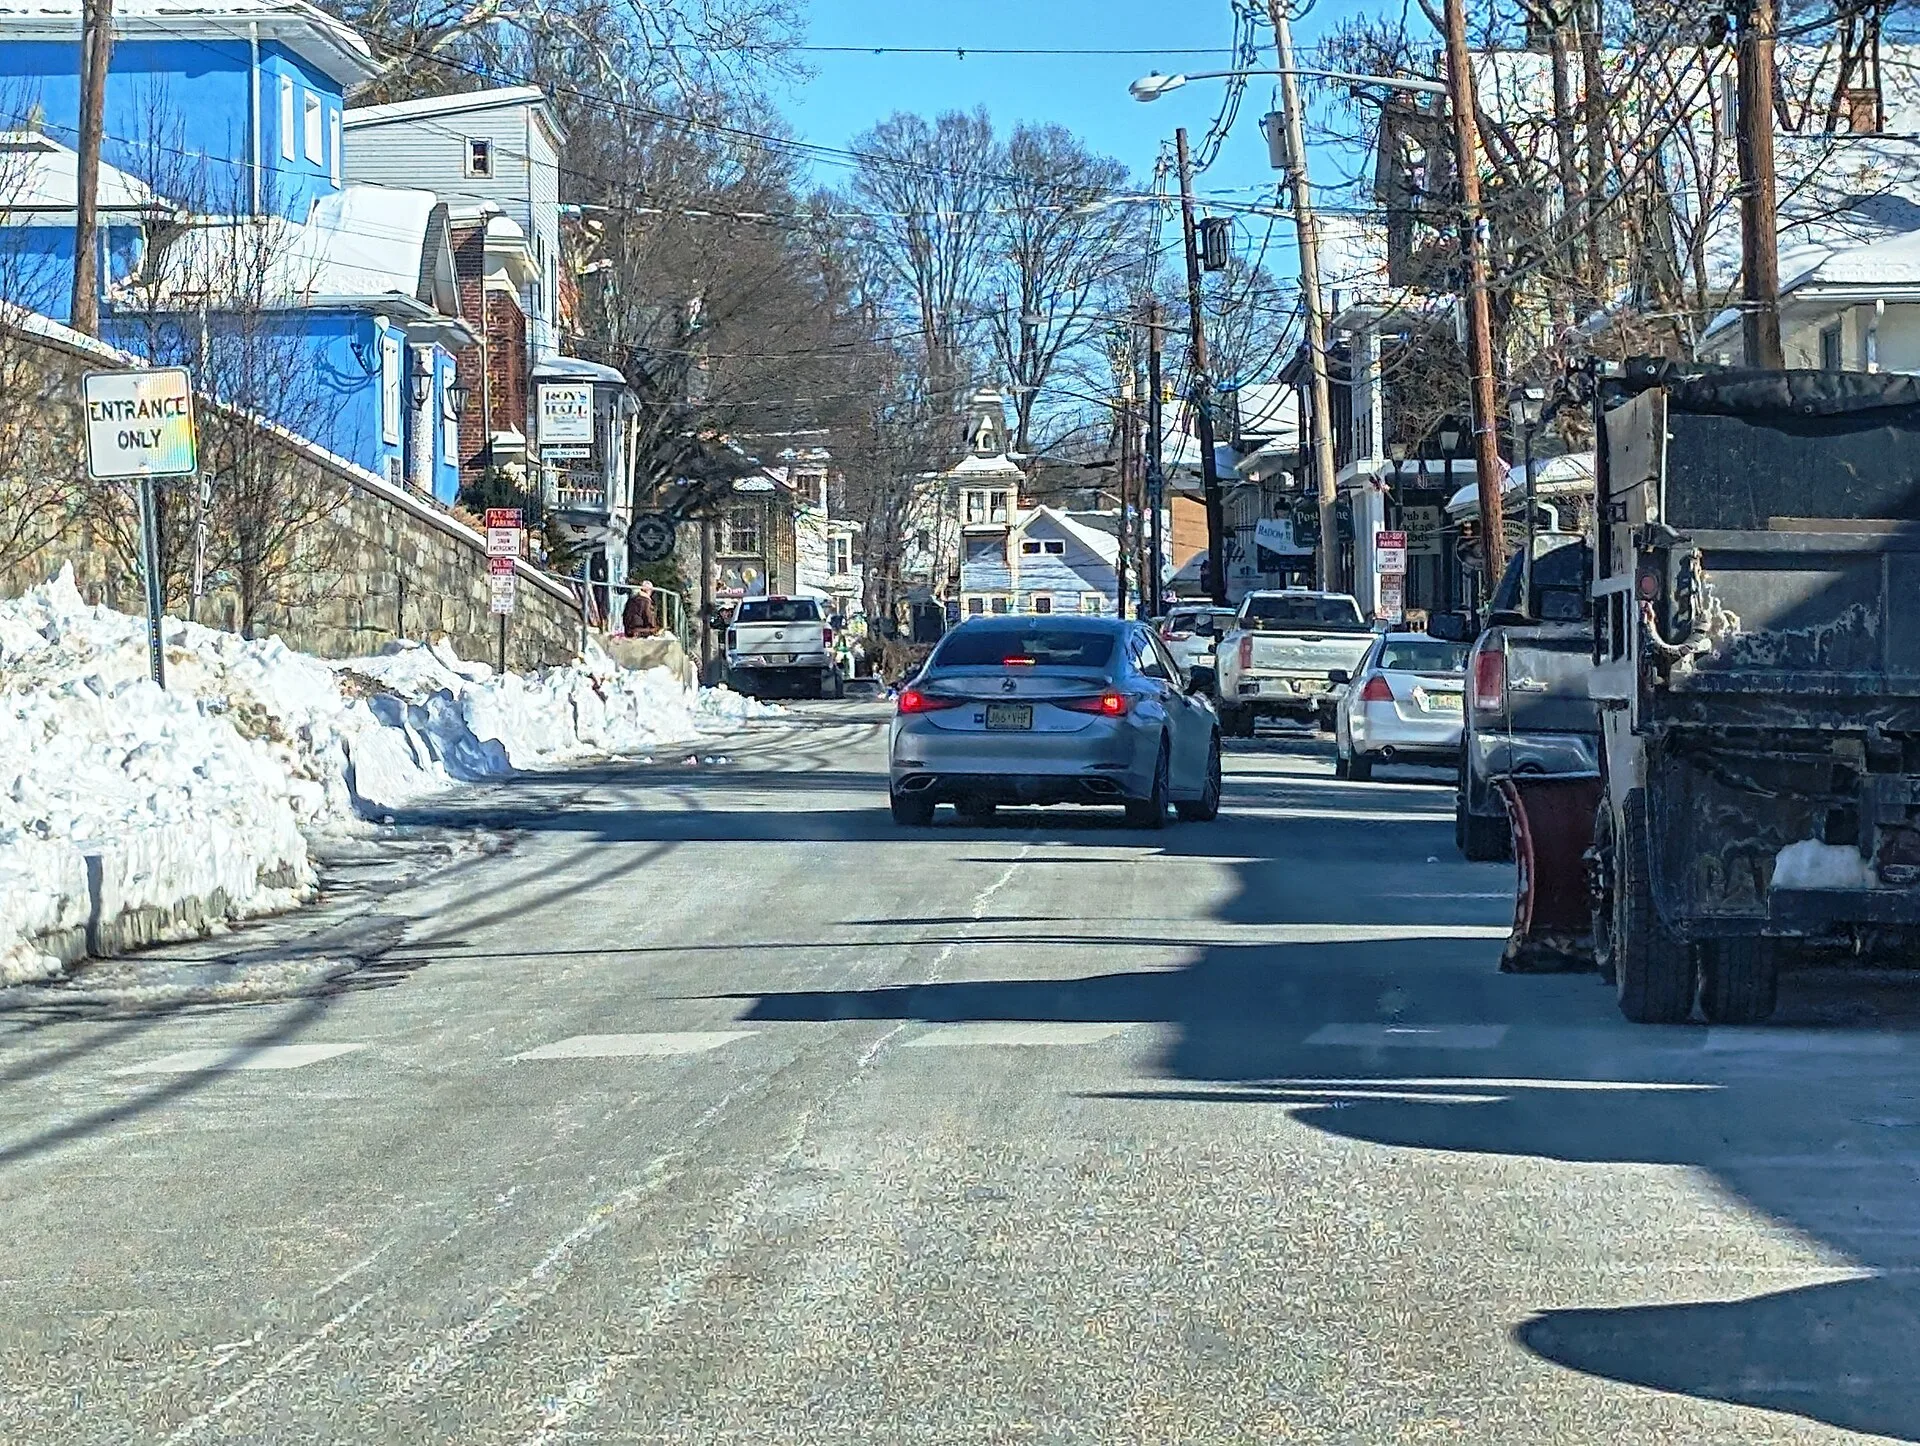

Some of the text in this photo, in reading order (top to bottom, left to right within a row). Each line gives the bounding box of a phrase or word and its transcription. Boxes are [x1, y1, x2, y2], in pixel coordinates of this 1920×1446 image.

[89, 397, 187, 421] ENTRANCE
[118, 429, 161, 450] ONLY
[491, 519, 517, 527] PARKING
[1297, 511, 1319, 525] Post
